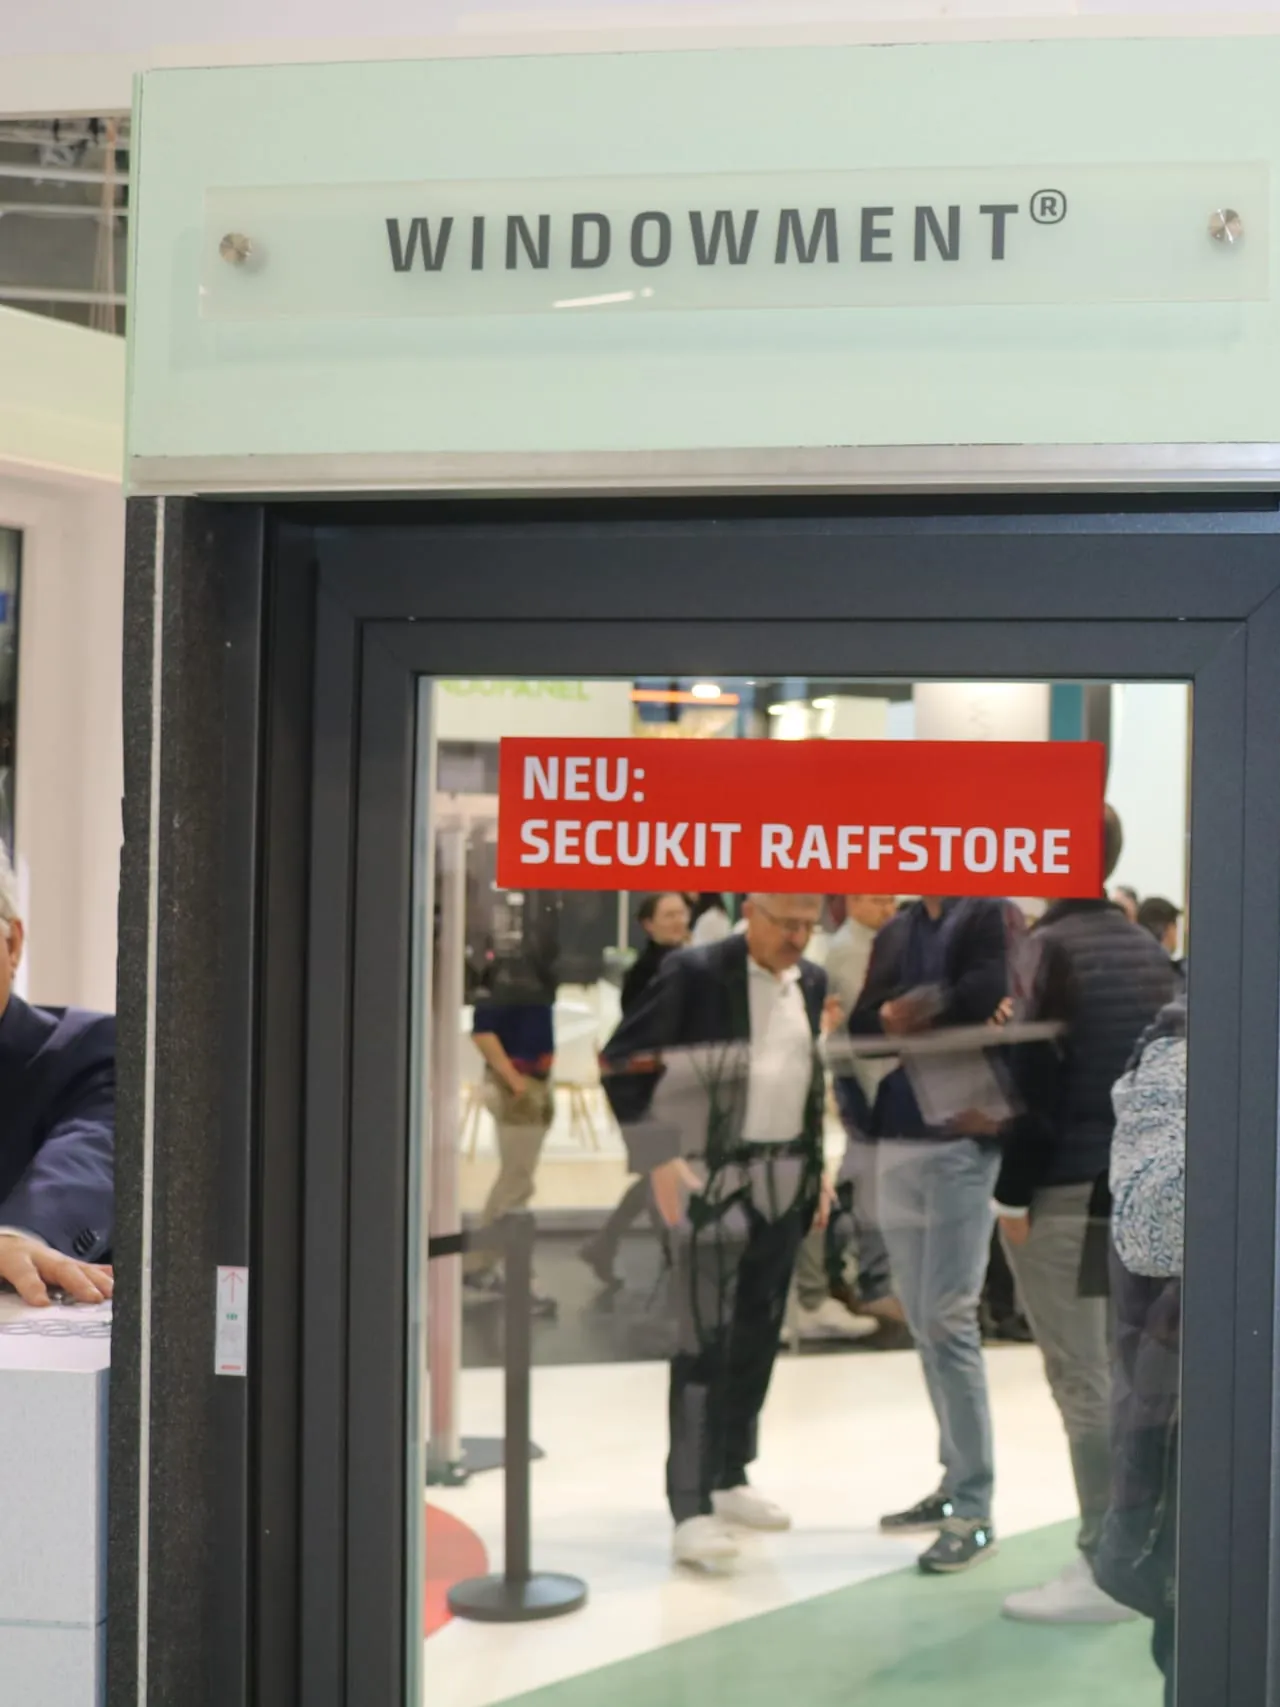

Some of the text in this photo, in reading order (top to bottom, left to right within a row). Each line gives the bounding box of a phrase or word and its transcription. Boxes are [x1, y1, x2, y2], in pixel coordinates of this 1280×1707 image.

[523, 755, 646, 802] NEU:
[519, 819, 1072, 875] SECUKIT RAFFSTORE
